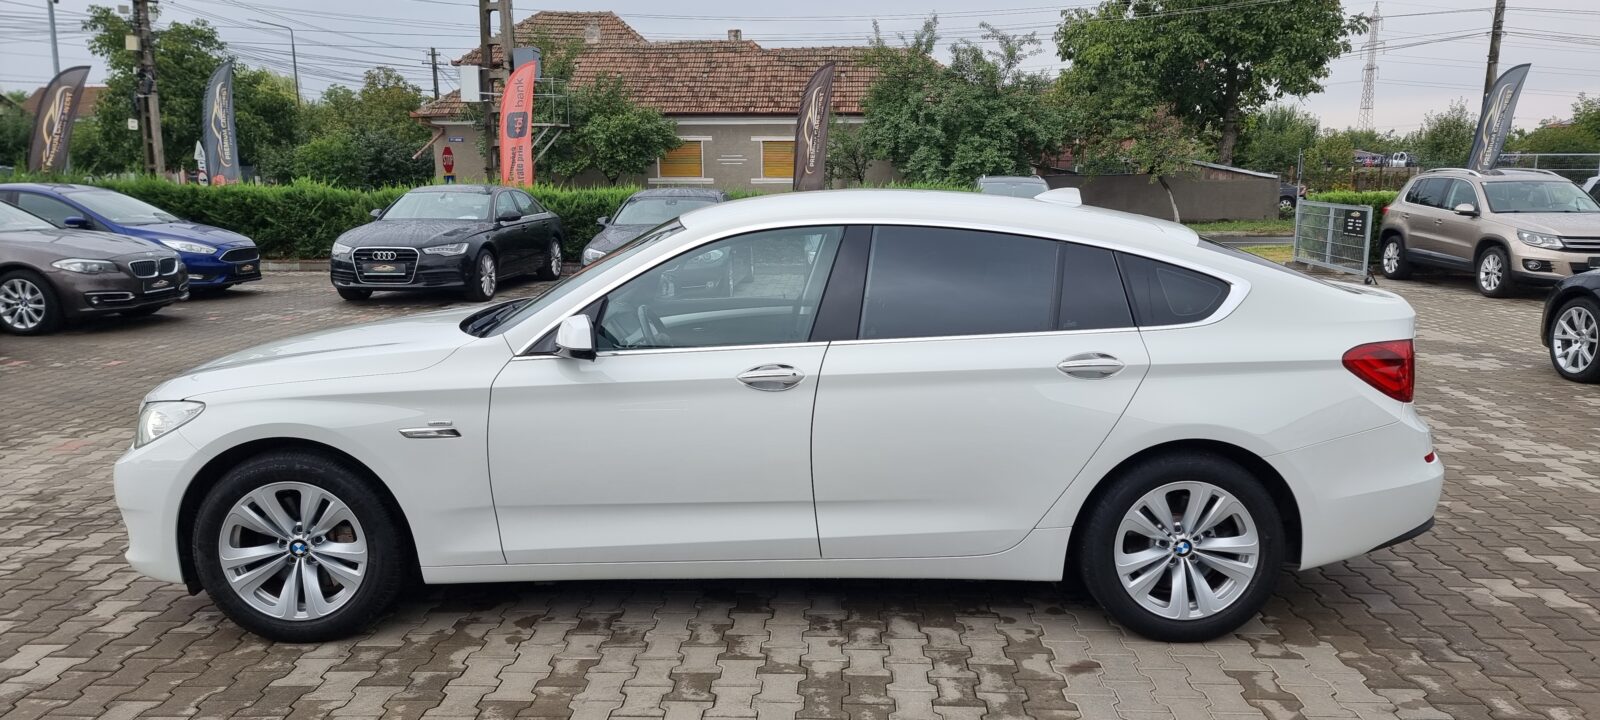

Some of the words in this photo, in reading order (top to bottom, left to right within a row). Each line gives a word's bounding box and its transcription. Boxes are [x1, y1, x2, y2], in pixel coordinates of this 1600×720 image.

[514, 78, 524, 108] bank
[222, 129, 231, 160] PREMIUM
[443, 154, 454, 165] STOP
[1483, 133, 1496, 166] PREMIUM
